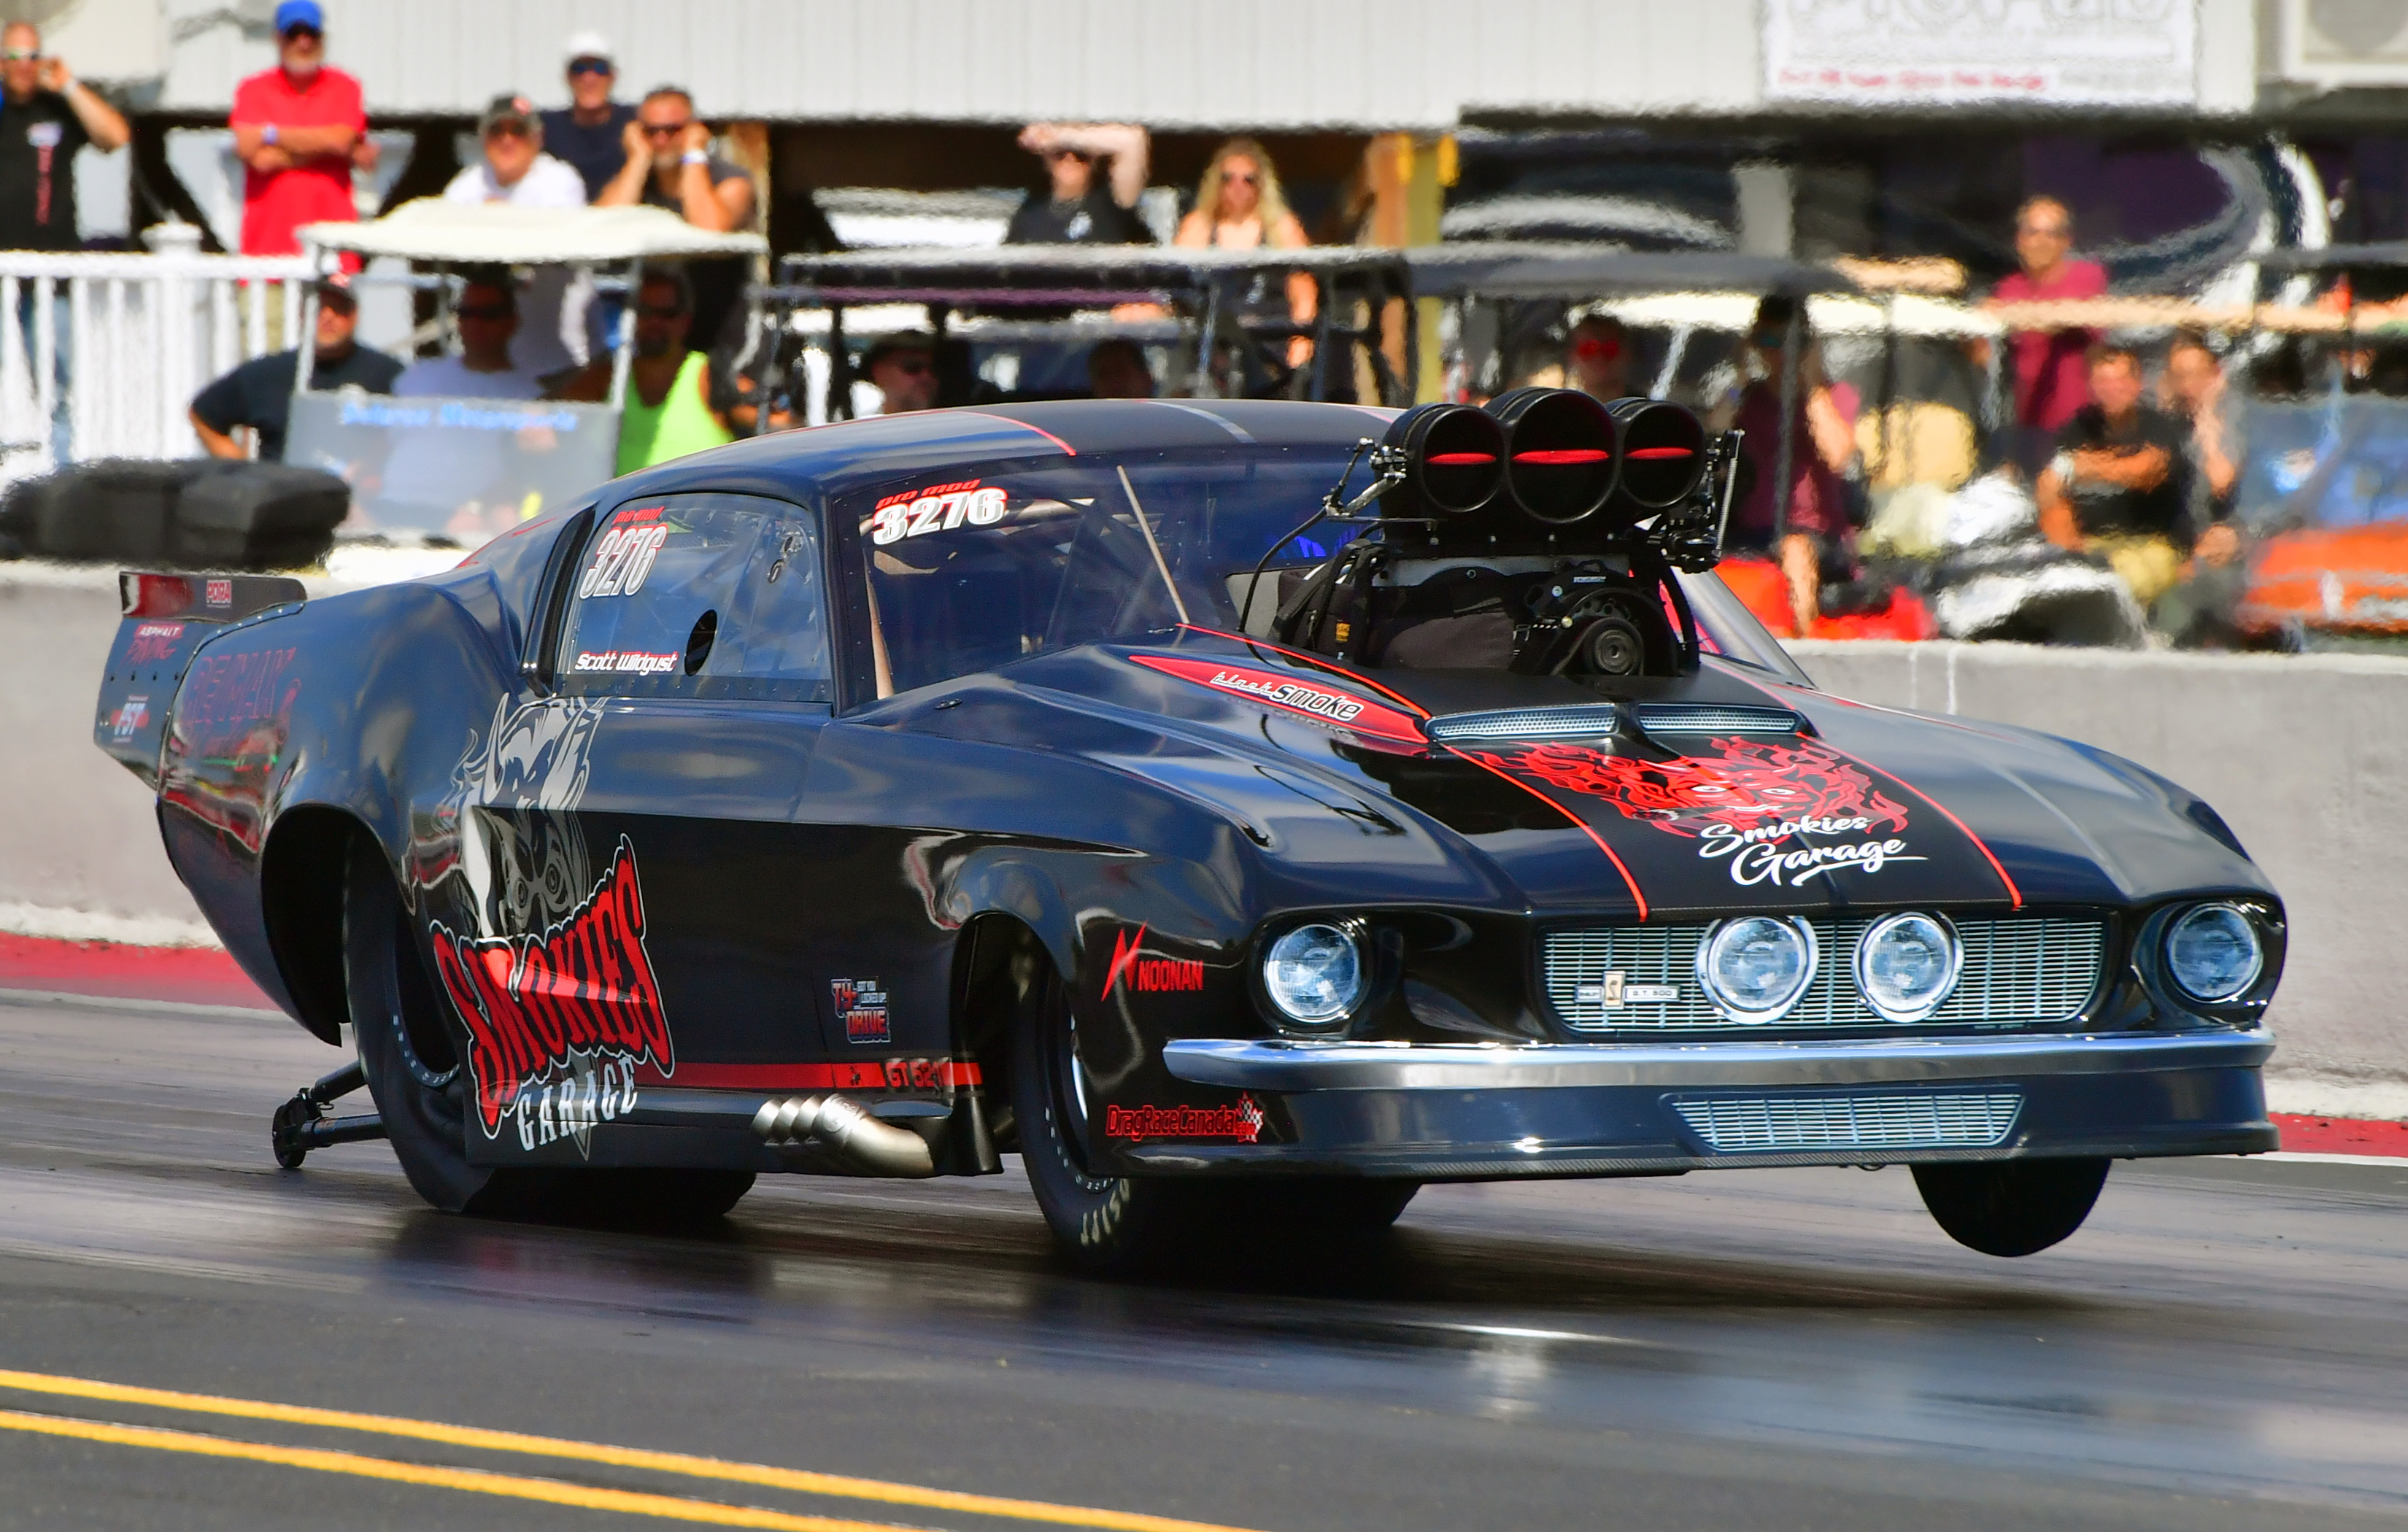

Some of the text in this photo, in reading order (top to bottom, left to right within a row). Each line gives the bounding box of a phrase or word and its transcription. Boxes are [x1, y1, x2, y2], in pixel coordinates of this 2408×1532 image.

[873, 487, 1008, 545] 3276
[579, 524, 668, 599] 3276
[1699, 816, 1872, 857] Smokies
[1731, 839, 1928, 886] Garage
[433, 850, 670, 1126] SMOKIES
[1138, 960, 1203, 991] NOONAN
[846, 1011, 887, 1034] DRIVE
[517, 1057, 638, 1151] GARAGE
